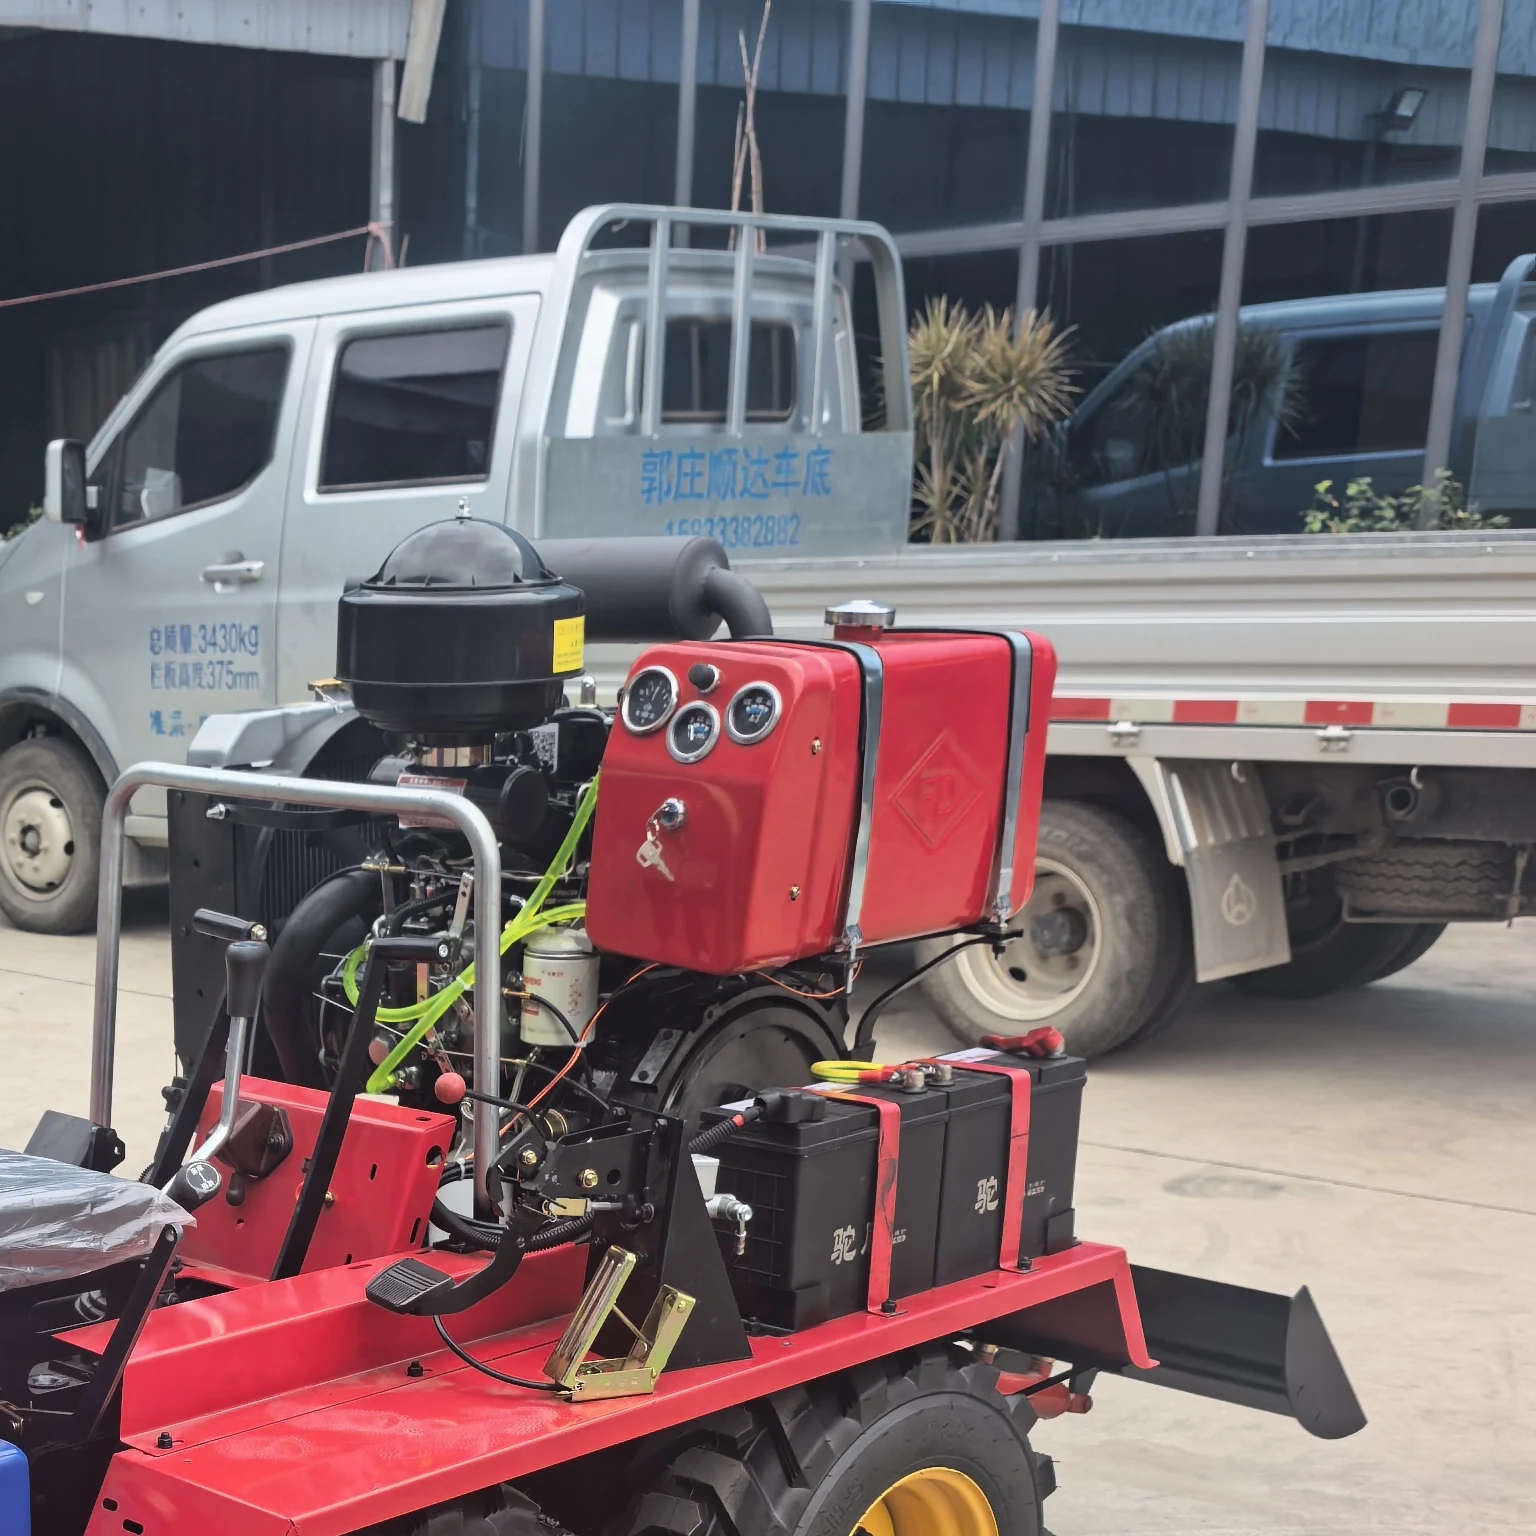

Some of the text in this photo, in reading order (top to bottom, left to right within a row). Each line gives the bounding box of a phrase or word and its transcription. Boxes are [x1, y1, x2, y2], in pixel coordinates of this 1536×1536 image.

[640, 444, 833, 506] 郭庄顺达车底
